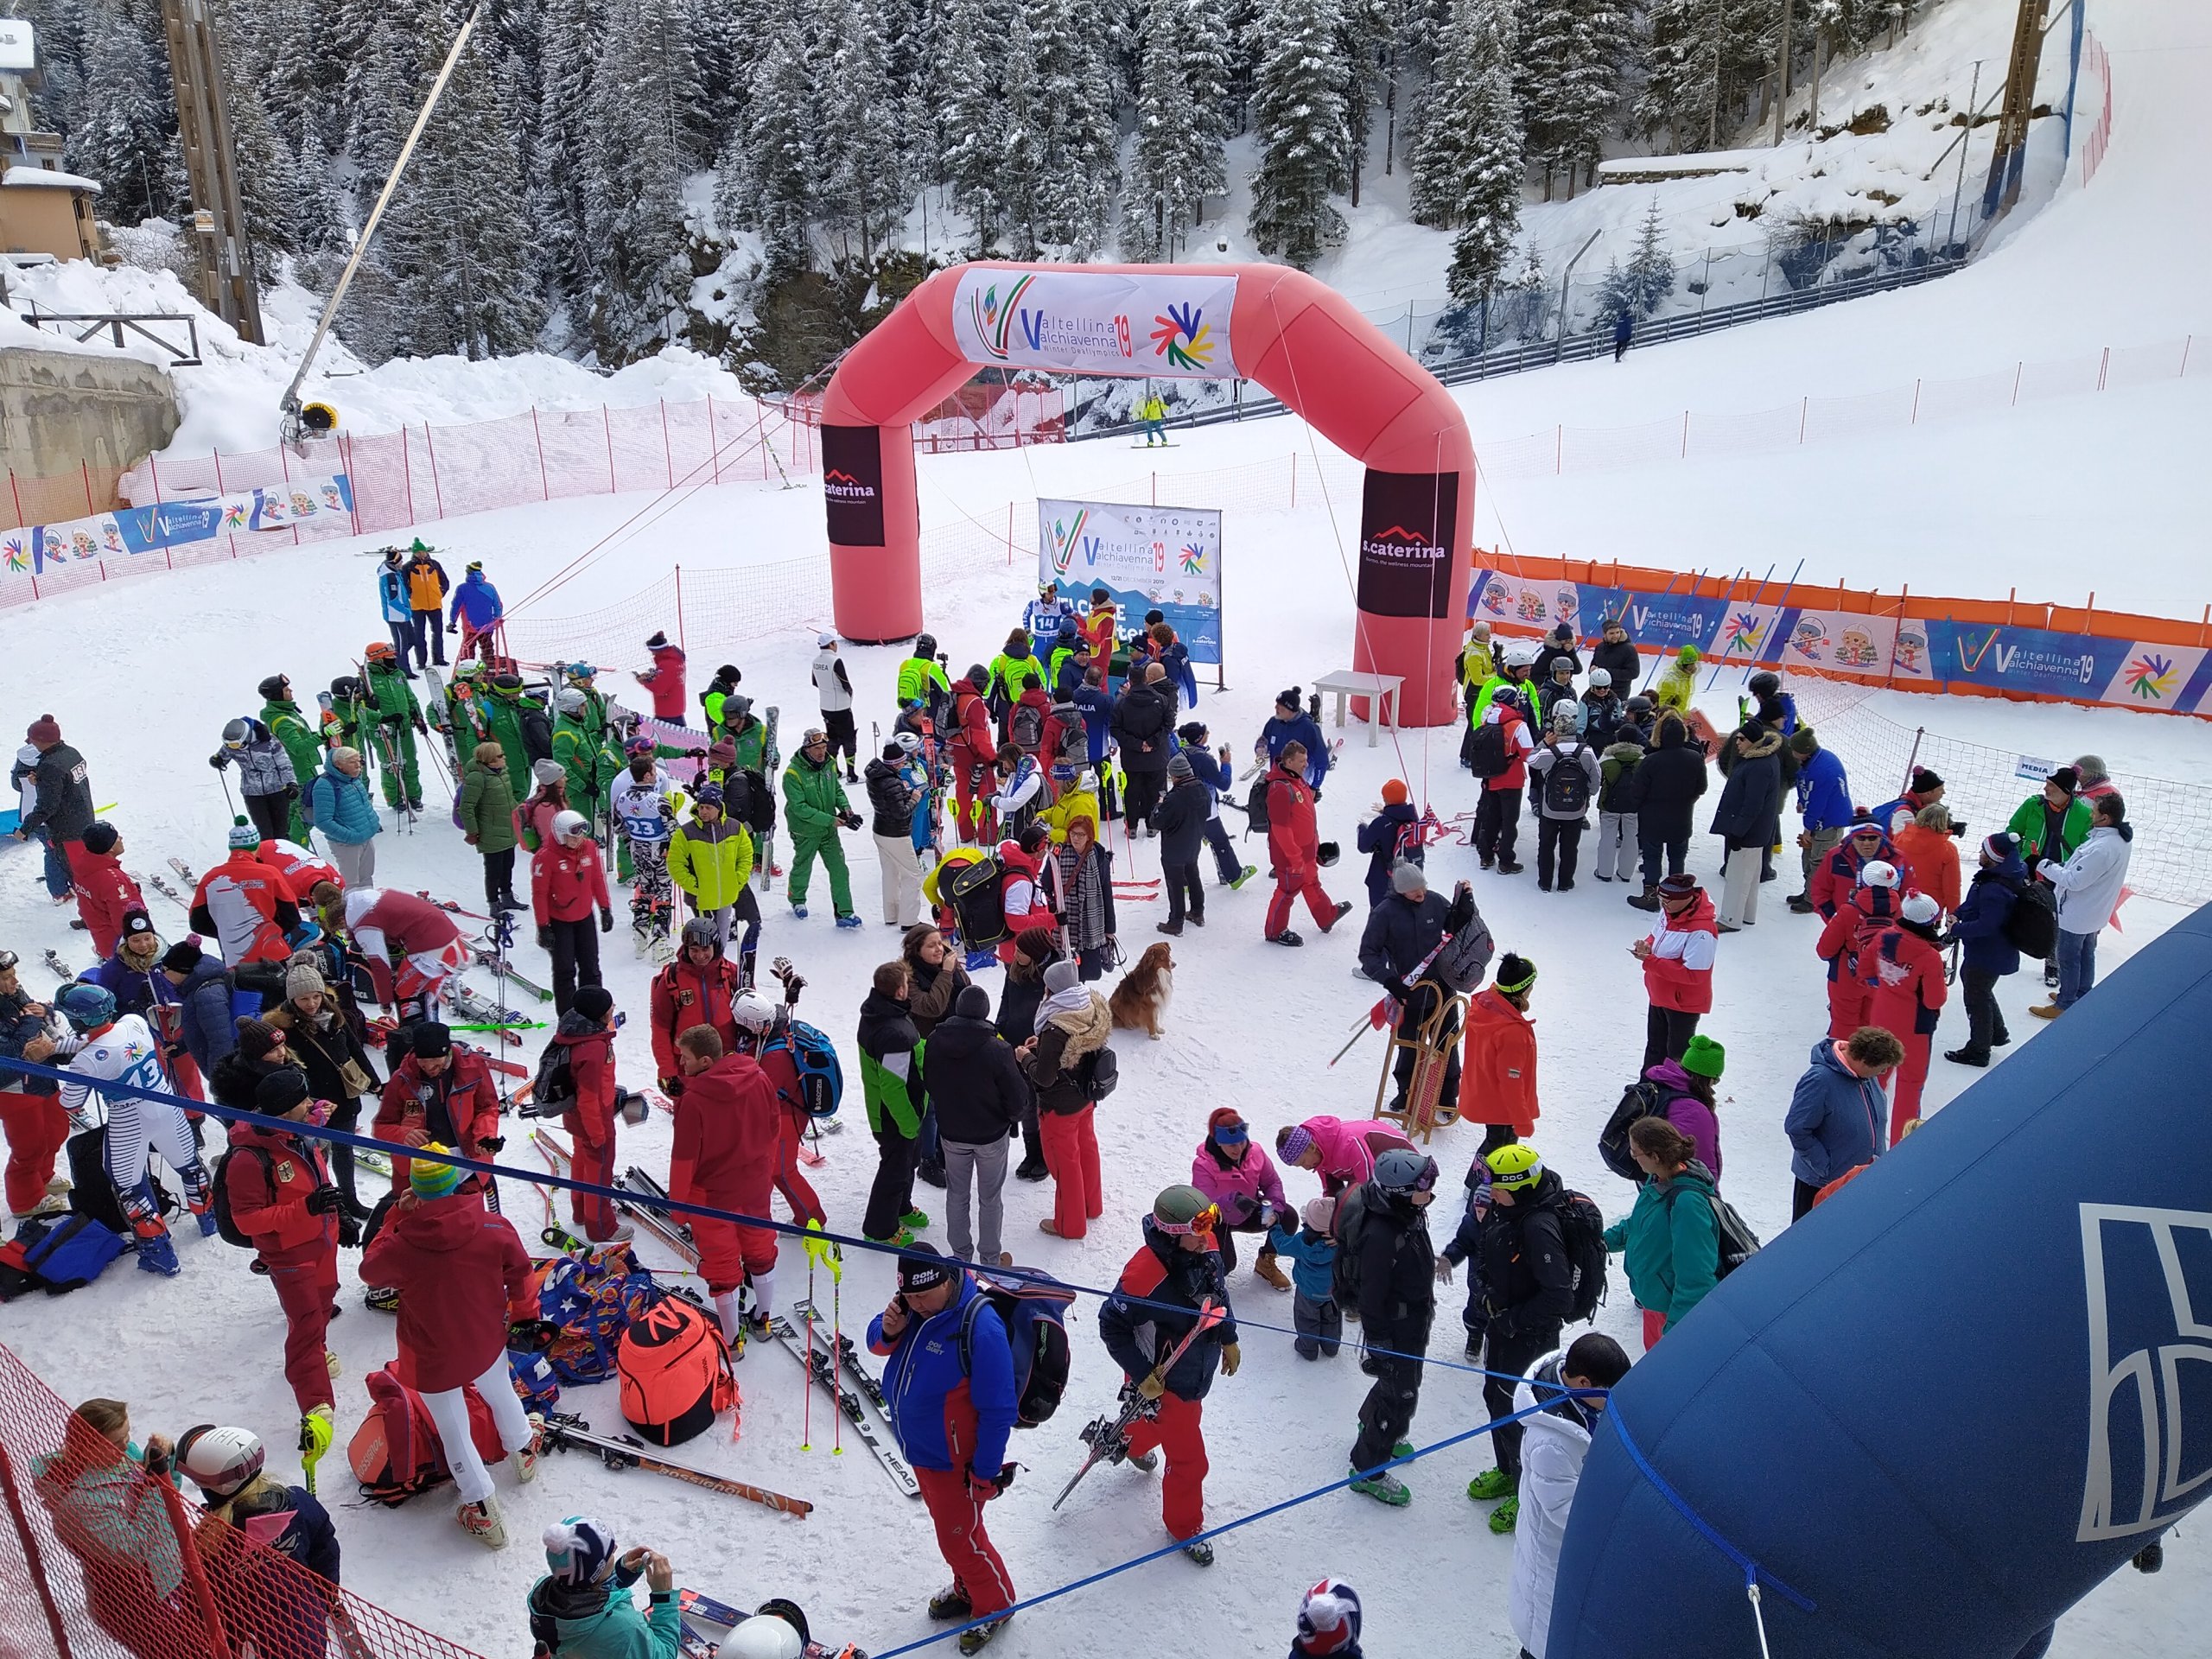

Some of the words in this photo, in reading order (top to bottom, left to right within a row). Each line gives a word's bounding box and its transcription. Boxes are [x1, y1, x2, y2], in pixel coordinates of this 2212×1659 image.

[1115, 315, 1132, 358] 19
[1071, 347, 1120, 357] Deaflympics
[1154, 543, 1164, 572] 19
[1363, 540, 1445, 558] s.caterina
[1038, 617, 1054, 629] 14
[1693, 613, 1702, 639] 19
[2080, 655, 2094, 683] 19
[2022, 763, 2048, 773] MEDIA
[626, 819, 655, 836] 23
[1502, 1173, 1524, 1182] POC
[912, 1268, 933, 1280] DON
[912, 1271, 939, 1286] QUIET
[1572, 1263, 1582, 1291] ABS
[925, 1344, 944, 1356] QUIET
[883, 1452, 917, 1488] HEAD
